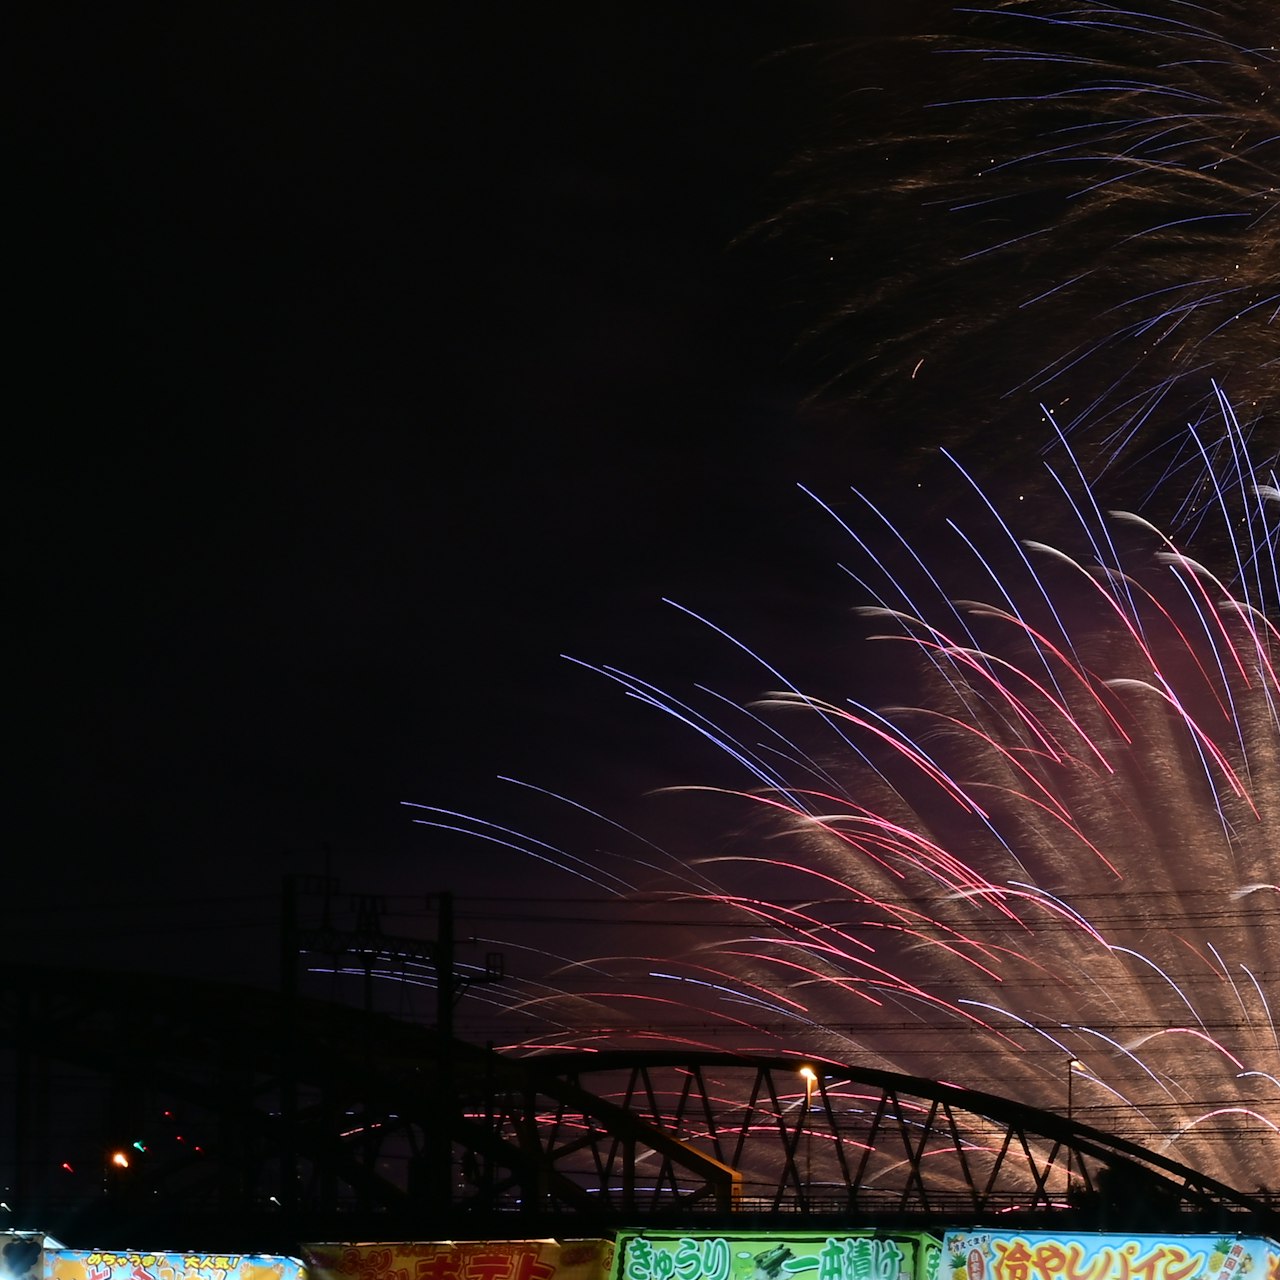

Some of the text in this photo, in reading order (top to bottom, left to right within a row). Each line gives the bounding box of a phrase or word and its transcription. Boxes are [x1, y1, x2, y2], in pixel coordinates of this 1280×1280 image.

[87, 1253, 164, 1267] めちゃうま!
[184, 1256, 240, 1270] 大人気!
